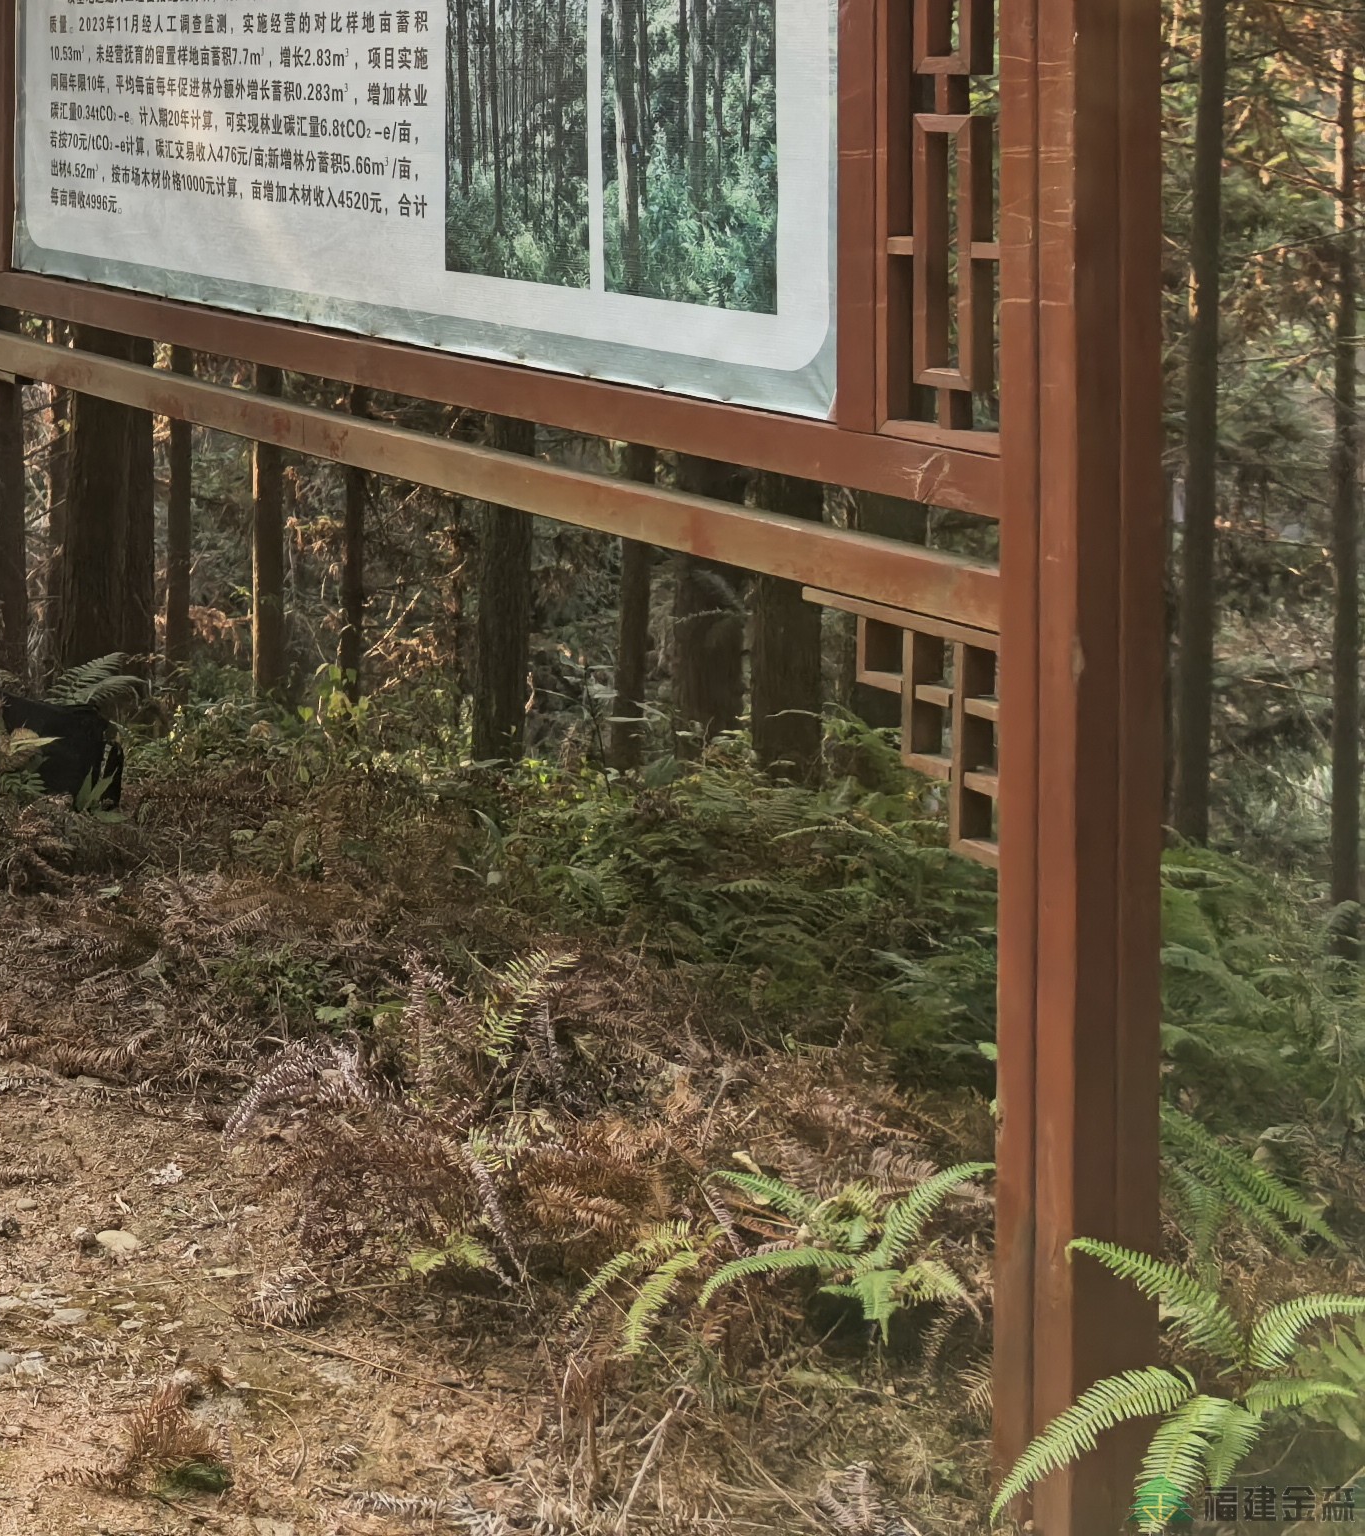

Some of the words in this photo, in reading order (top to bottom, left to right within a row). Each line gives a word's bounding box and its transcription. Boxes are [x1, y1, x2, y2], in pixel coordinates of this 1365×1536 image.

[50, 187, 123, 215] 每亩增收4996元。
